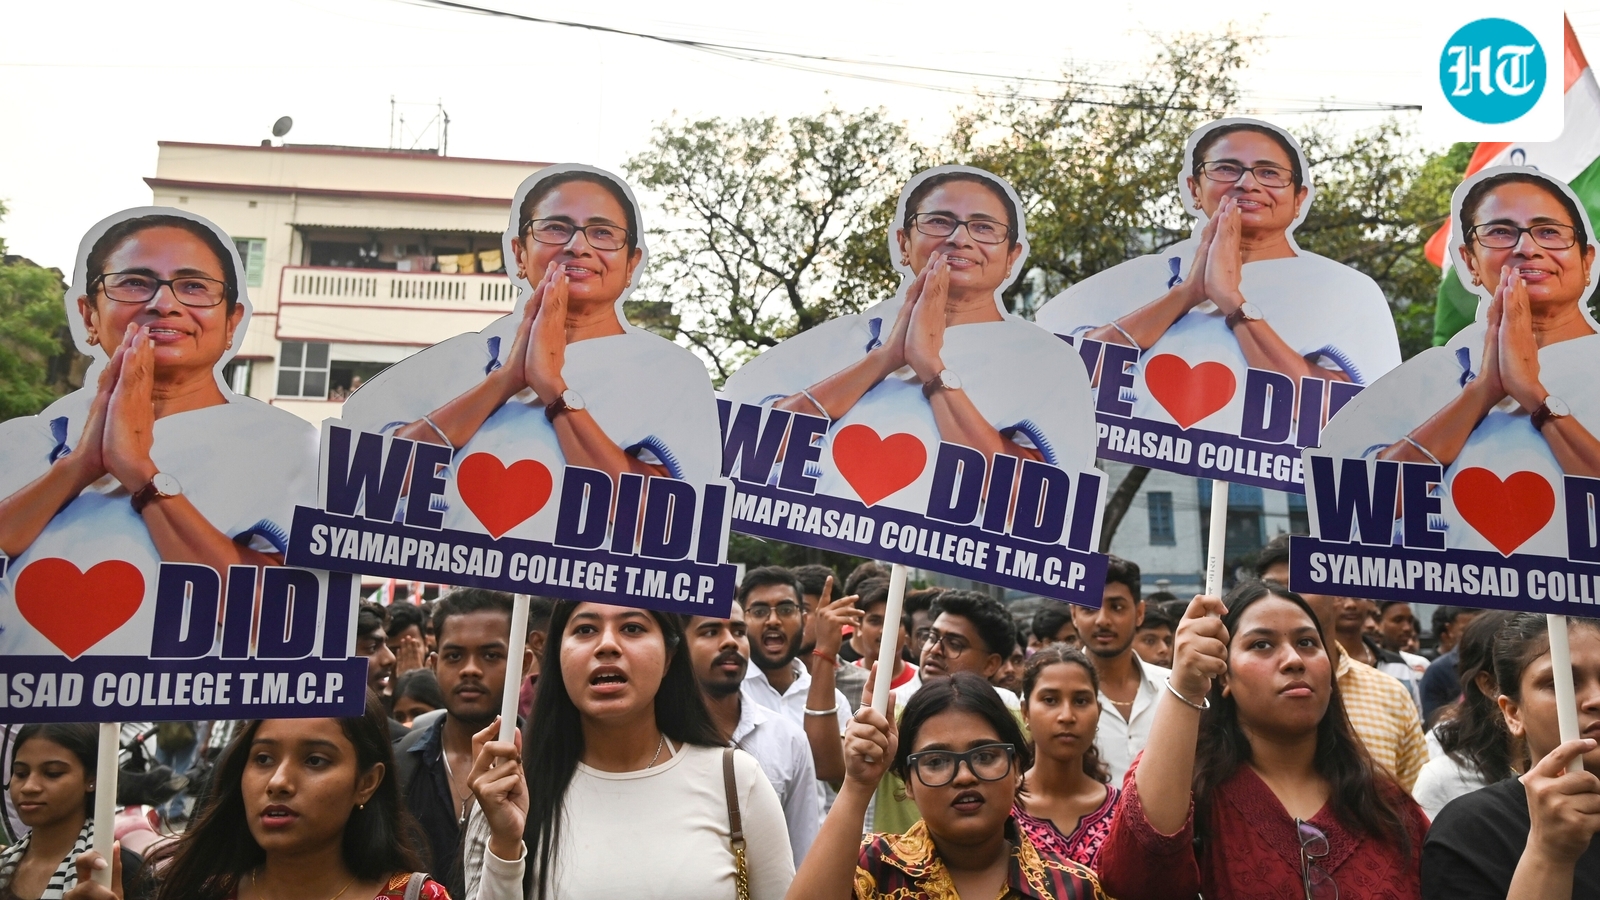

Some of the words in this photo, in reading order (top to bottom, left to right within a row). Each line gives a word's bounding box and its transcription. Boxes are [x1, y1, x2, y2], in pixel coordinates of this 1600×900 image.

[1053, 333, 1139, 419] E
[1239, 367, 1366, 449] DI
[325, 425, 454, 531] WE
[552, 465, 728, 566] DIDI
[717, 399, 831, 496] WE
[924, 441, 1101, 554] DIDI
[1096, 422, 1192, 465] PRASAD
[1198, 442, 1304, 484] COLLEGE
[1311, 455, 1447, 551] WE
[310, 524, 503, 578] SYAMAPRASAD
[509, 553, 618, 592] COLLEGE
[625, 567, 715, 605] T.M.C.P.
[880, 521, 989, 570] COLLEGE
[995, 545, 1086, 592] T.M.C.P.
[1309, 552, 1519, 598] SYAMAPRASAD
[148, 562, 349, 661] DIDI
[93, 672, 233, 707] COLLEGE
[240, 672, 345, 705] T.M.C.P.
